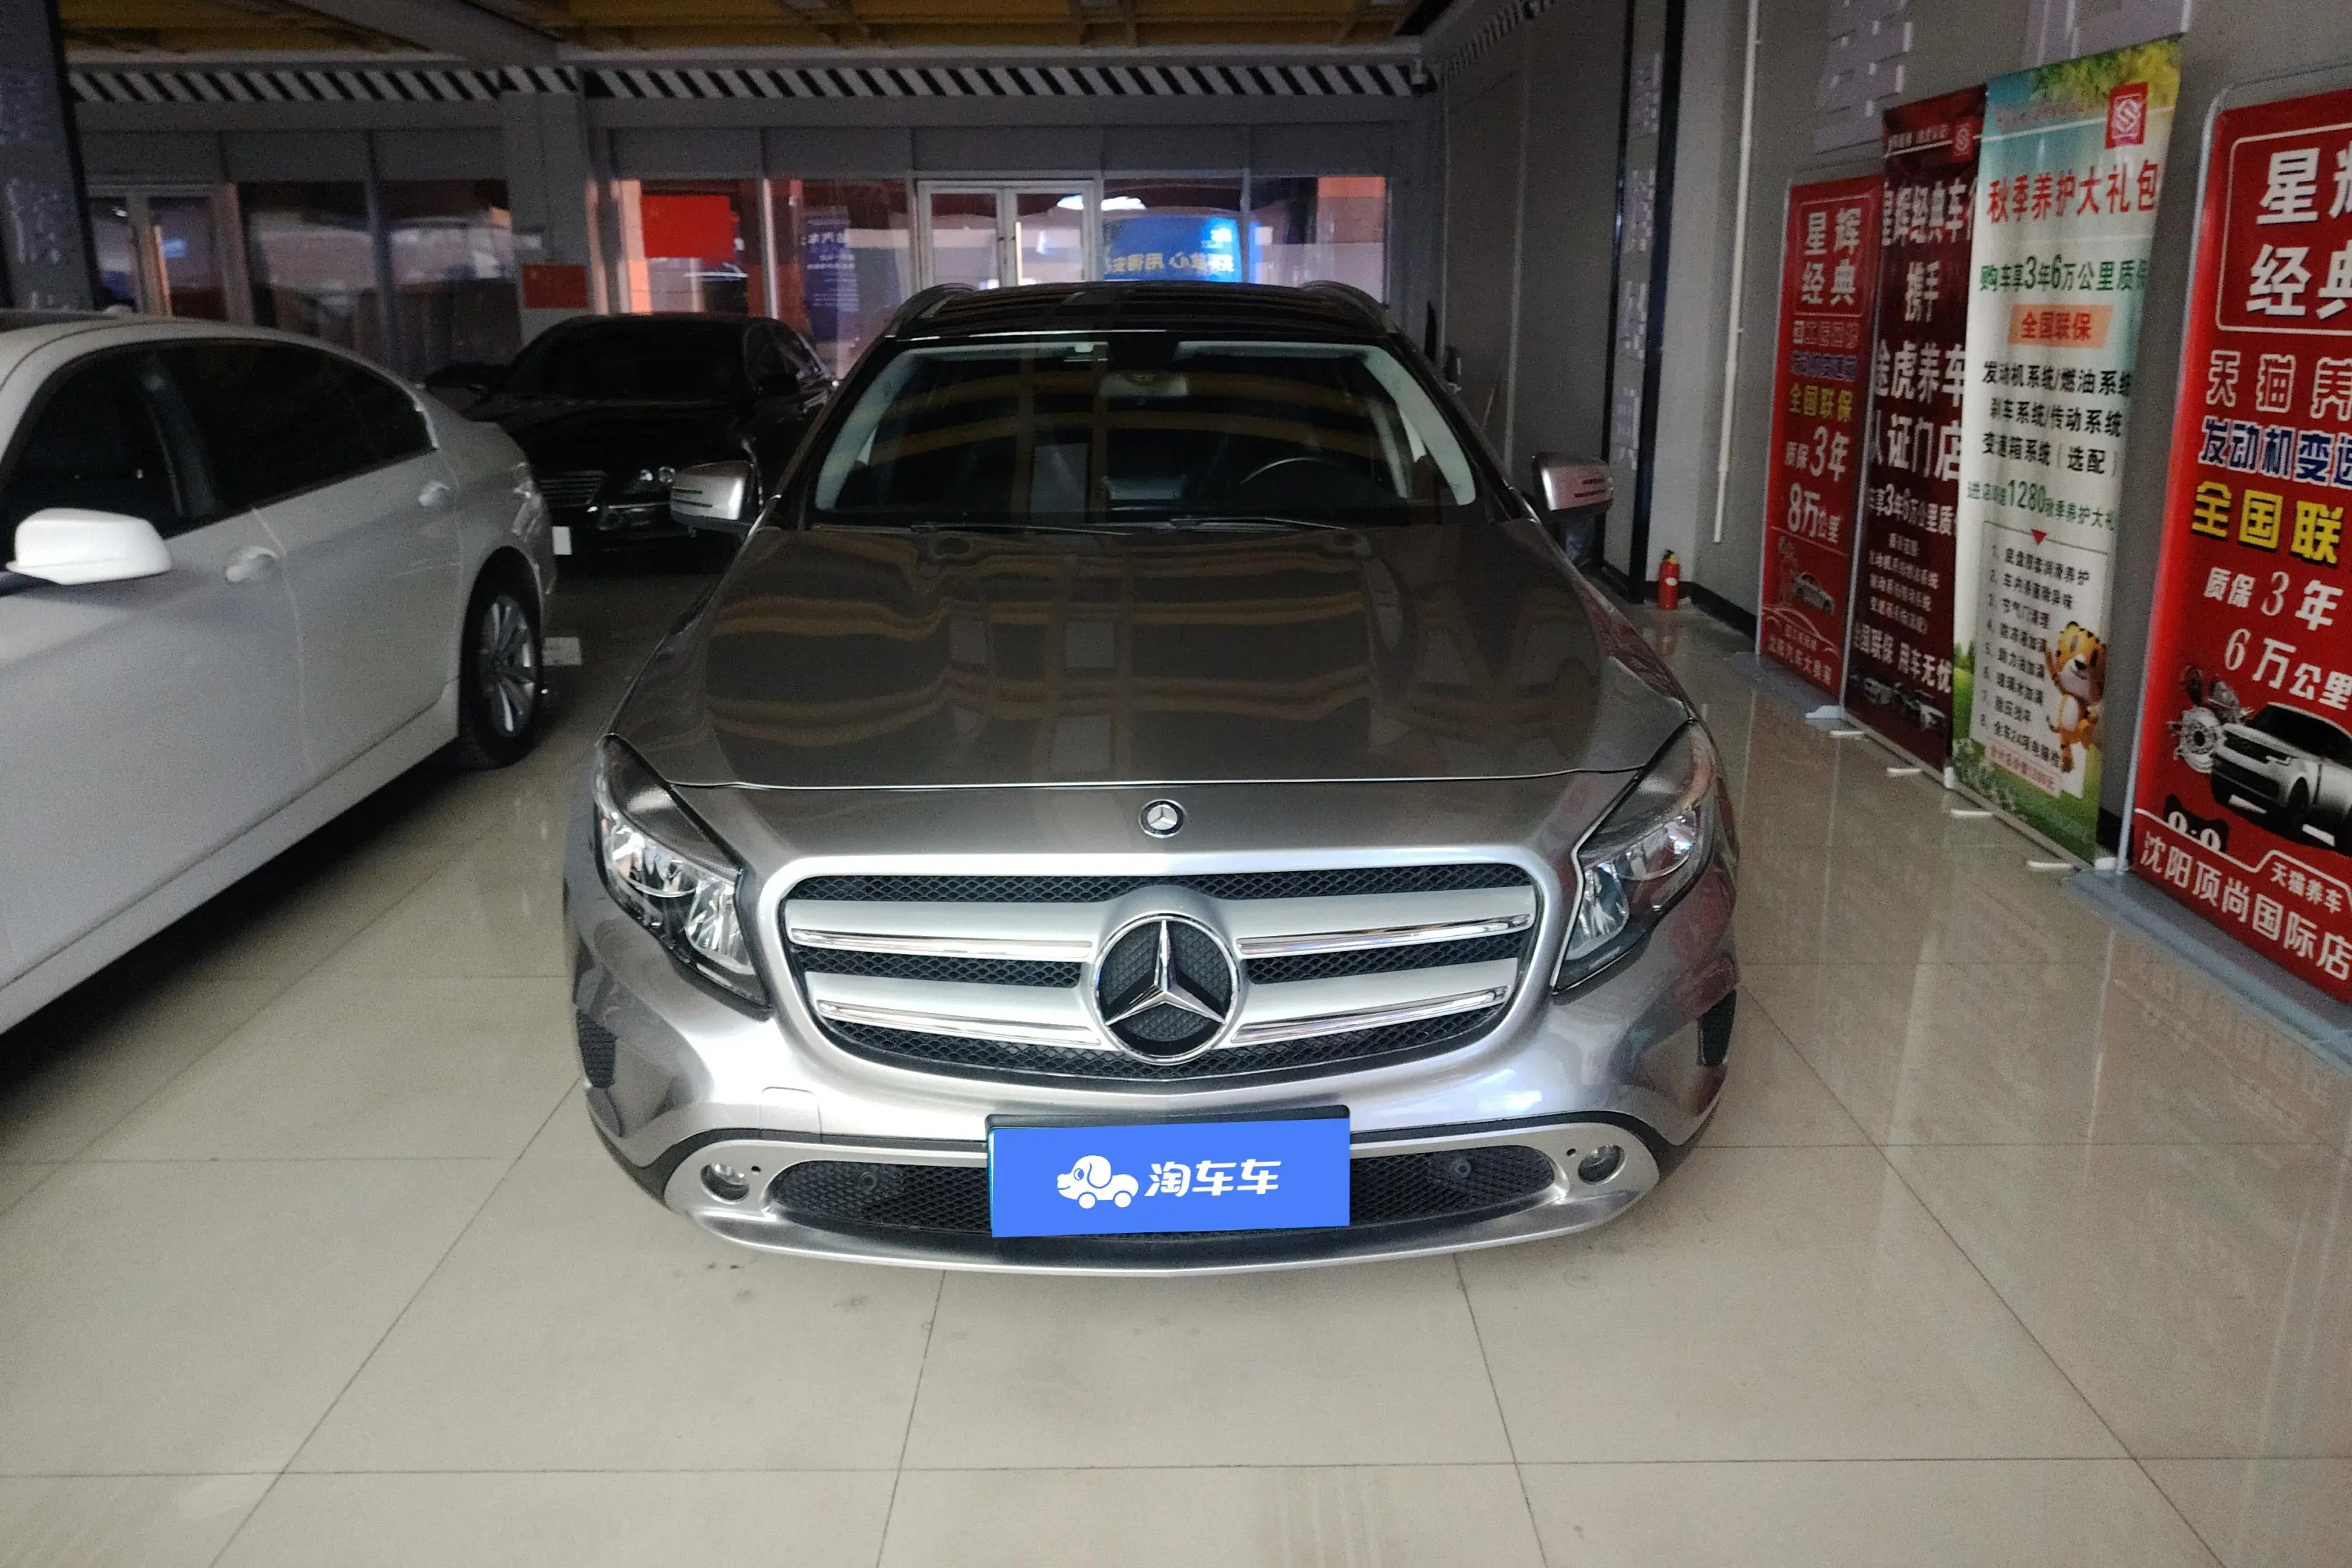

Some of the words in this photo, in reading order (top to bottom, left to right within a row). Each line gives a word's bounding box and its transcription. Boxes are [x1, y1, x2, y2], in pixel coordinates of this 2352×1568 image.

[1882, 178, 1977, 246] 星辉经典车
[1987, 159, 2159, 225] 秋季养护大礼包
[1804, 207, 1862, 256] 星辉
[1801, 258, 1857, 306] 经典
[1905, 261, 1940, 322] 携手
[2021, 311, 2092, 342] 全国联保
[1789, 383, 1853, 422] 全国联保
[2191, 481, 2345, 565] 全国联
[2204, 566, 2344, 631] 质保3年
[2224, 628, 2352, 710] 6万公里
[2140, 830, 2352, 981] 沈阳顶尚国际店
[2271, 861, 2342, 913] 天猫养车
